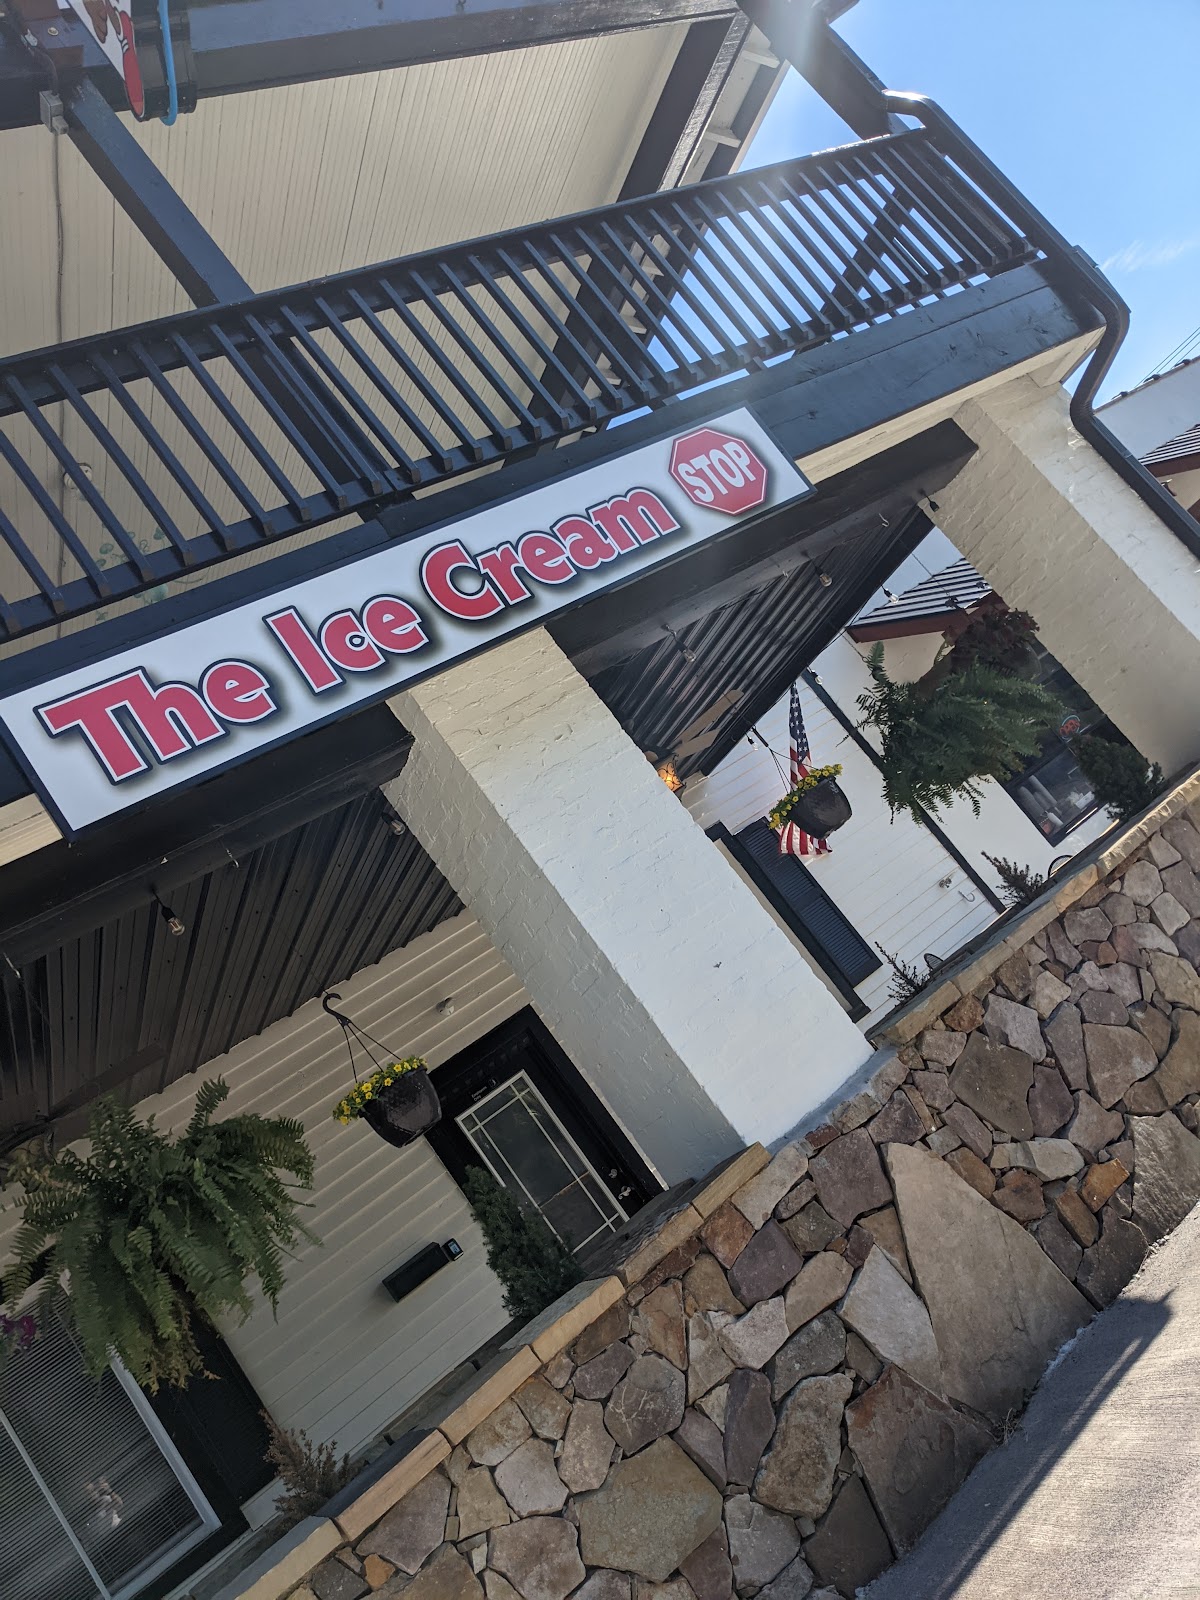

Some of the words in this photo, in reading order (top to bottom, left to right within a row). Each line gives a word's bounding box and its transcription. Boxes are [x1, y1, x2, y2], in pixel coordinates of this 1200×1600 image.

[34, 659, 279, 785] The
[263, 595, 429, 694] Ice
[420, 487, 681, 622] Cream
[677, 441, 757, 503] STOP
